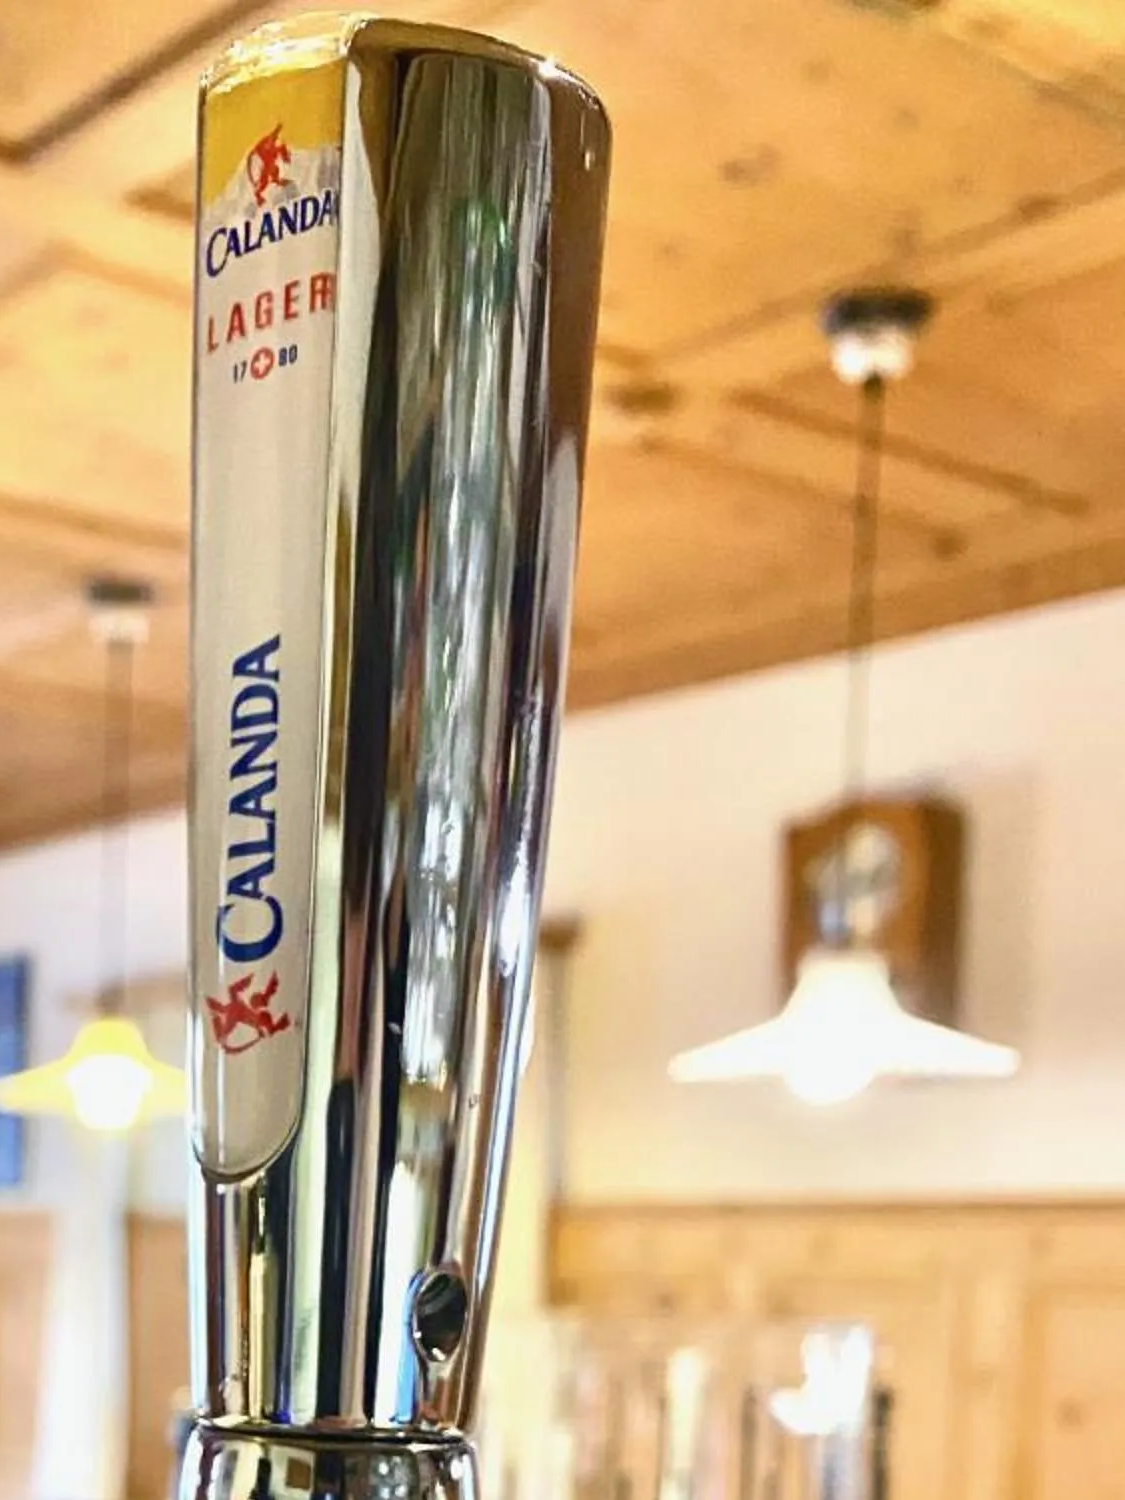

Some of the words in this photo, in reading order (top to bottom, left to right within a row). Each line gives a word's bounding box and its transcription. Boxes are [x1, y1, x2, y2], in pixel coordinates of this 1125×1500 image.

[206, 188, 335, 278] CALANDA
[207, 271, 335, 354] LAGER
[214, 634, 284, 963] CALANDA
